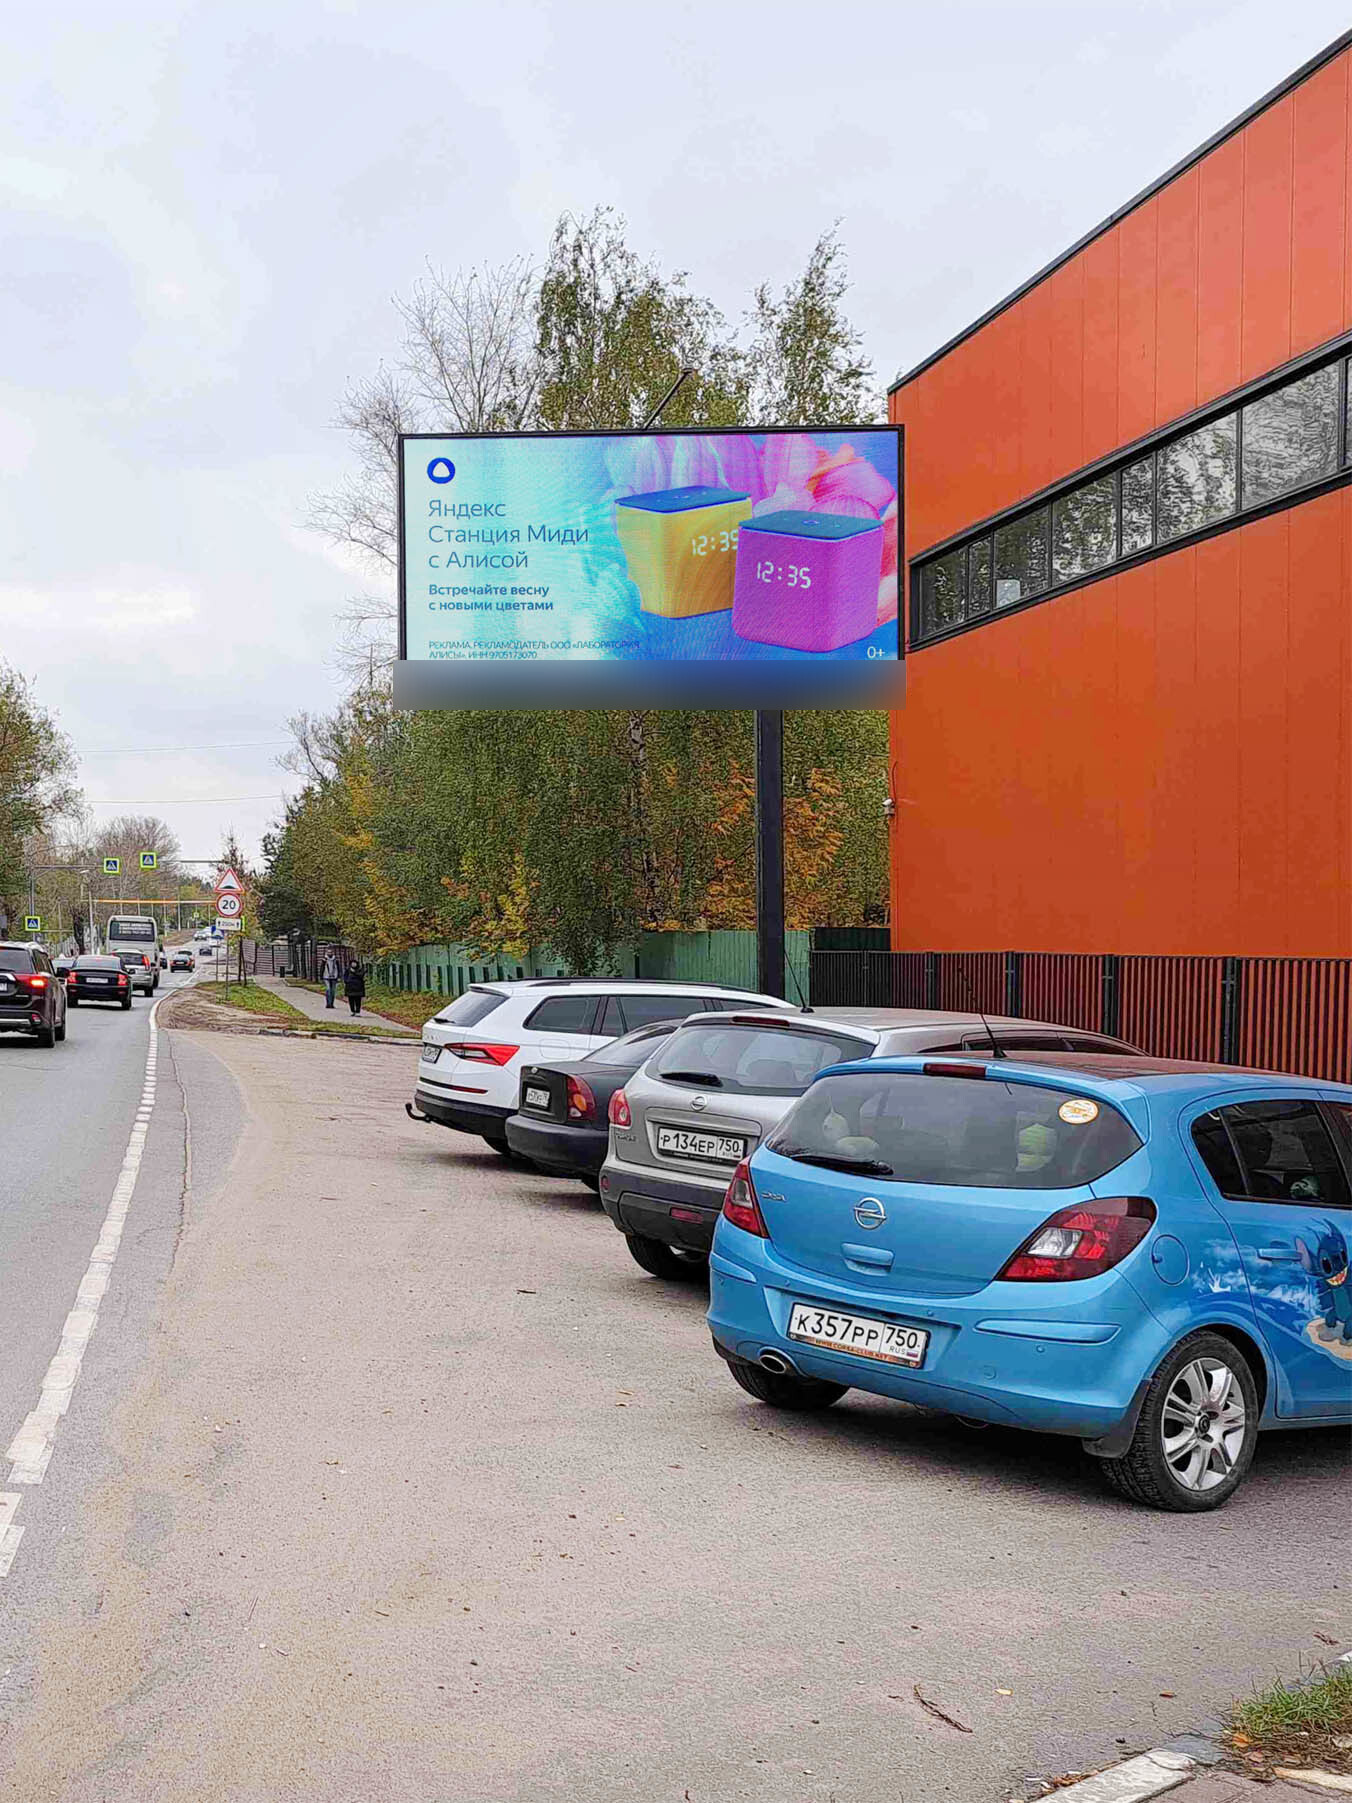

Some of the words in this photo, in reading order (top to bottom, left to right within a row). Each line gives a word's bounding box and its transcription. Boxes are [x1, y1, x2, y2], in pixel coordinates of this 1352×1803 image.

[428, 499, 507, 520] Яндекс
[428, 525, 521, 546] Станция
[527, 524, 589, 546] Миди
[428, 555, 440, 568] с
[446, 551, 528, 568] Алисой
[756, 561, 812, 589] 12:35
[428, 584, 508, 597] Встречайте
[510, 585, 550, 597] весну
[428, 601, 436, 610] с
[439, 601, 493, 611] новыми
[496, 601, 554, 612] цветами
[550, 640, 571, 649] ООО
[867, 646, 886, 659] 0+
[222, 899, 236, 910] 20
[662, 1133, 715, 1153] Р134ЕР
[718, 1138, 740, 1153] 750
[797, 1312, 879, 1346] К357РР
[885, 1326, 918, 1349] 750
[888, 1346, 906, 1355] RUS
